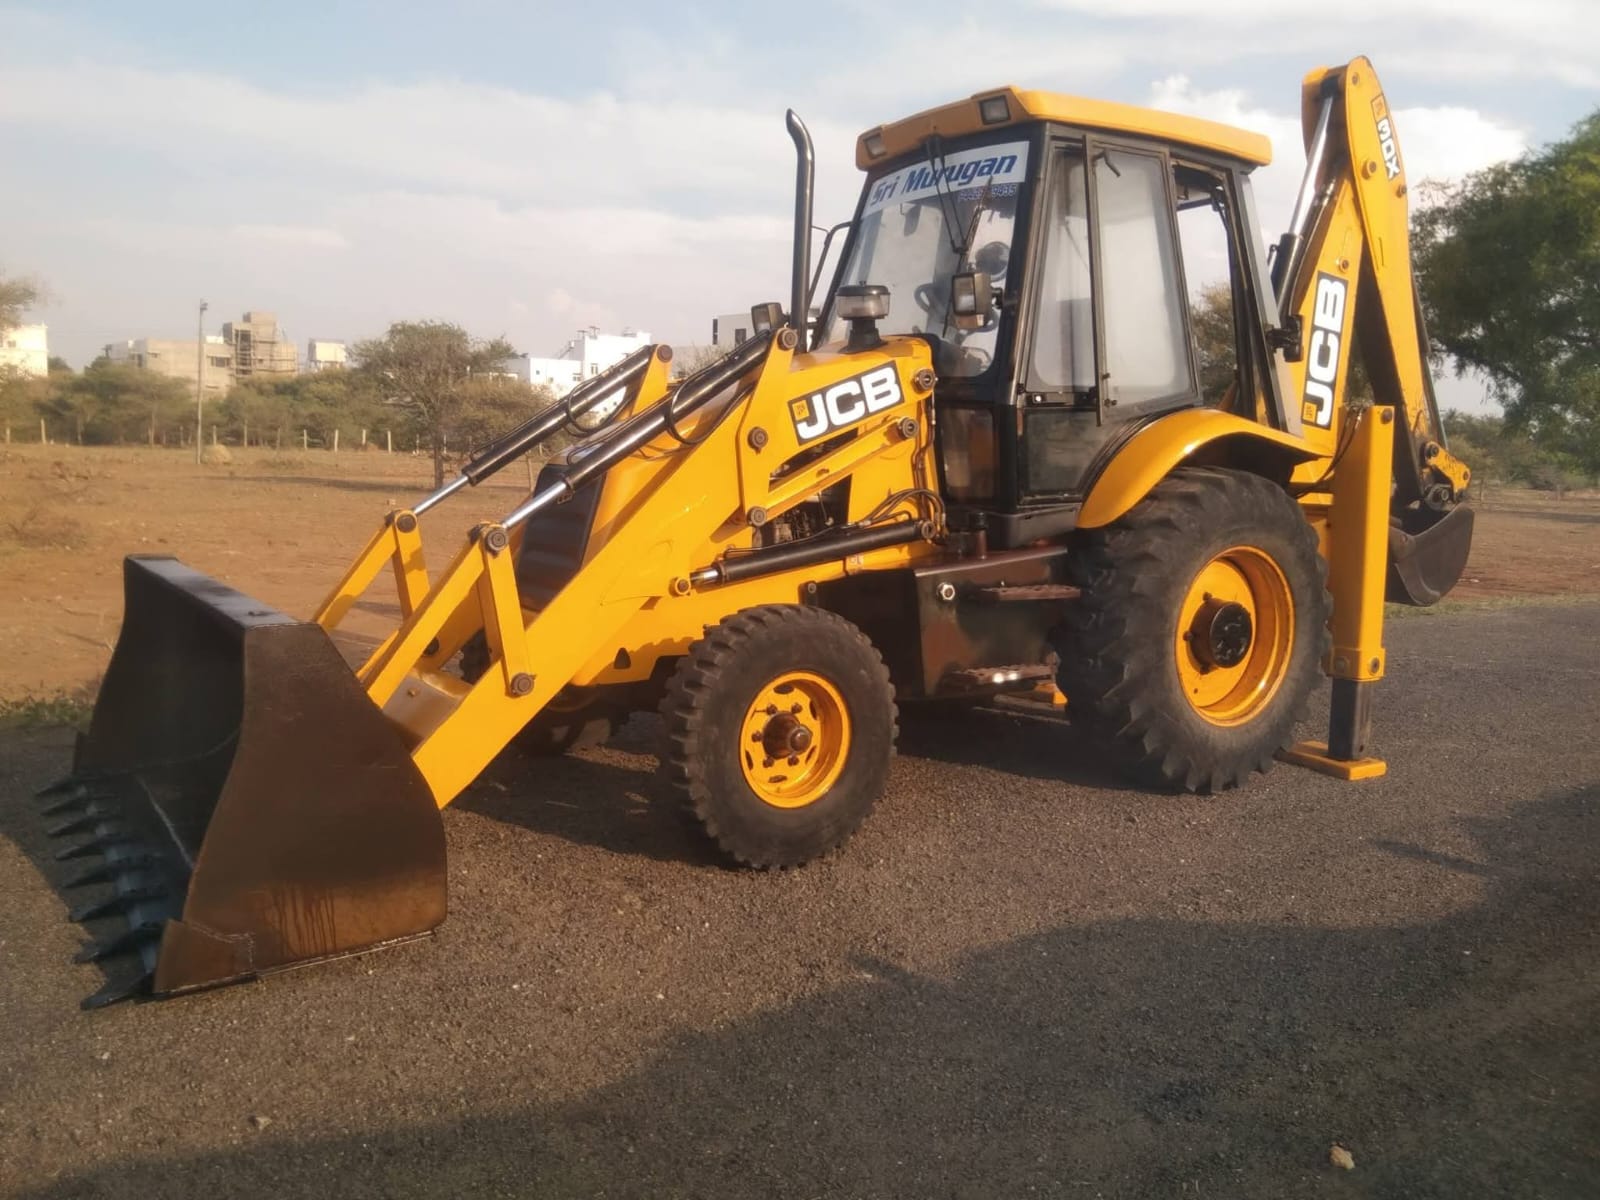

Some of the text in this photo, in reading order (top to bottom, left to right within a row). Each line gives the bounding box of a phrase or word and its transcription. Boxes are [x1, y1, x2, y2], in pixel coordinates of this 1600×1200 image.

[870, 154, 1018, 206] Sri Murugan
[1306, 278, 1345, 426] JCB
[797, 367, 901, 439] JCB
